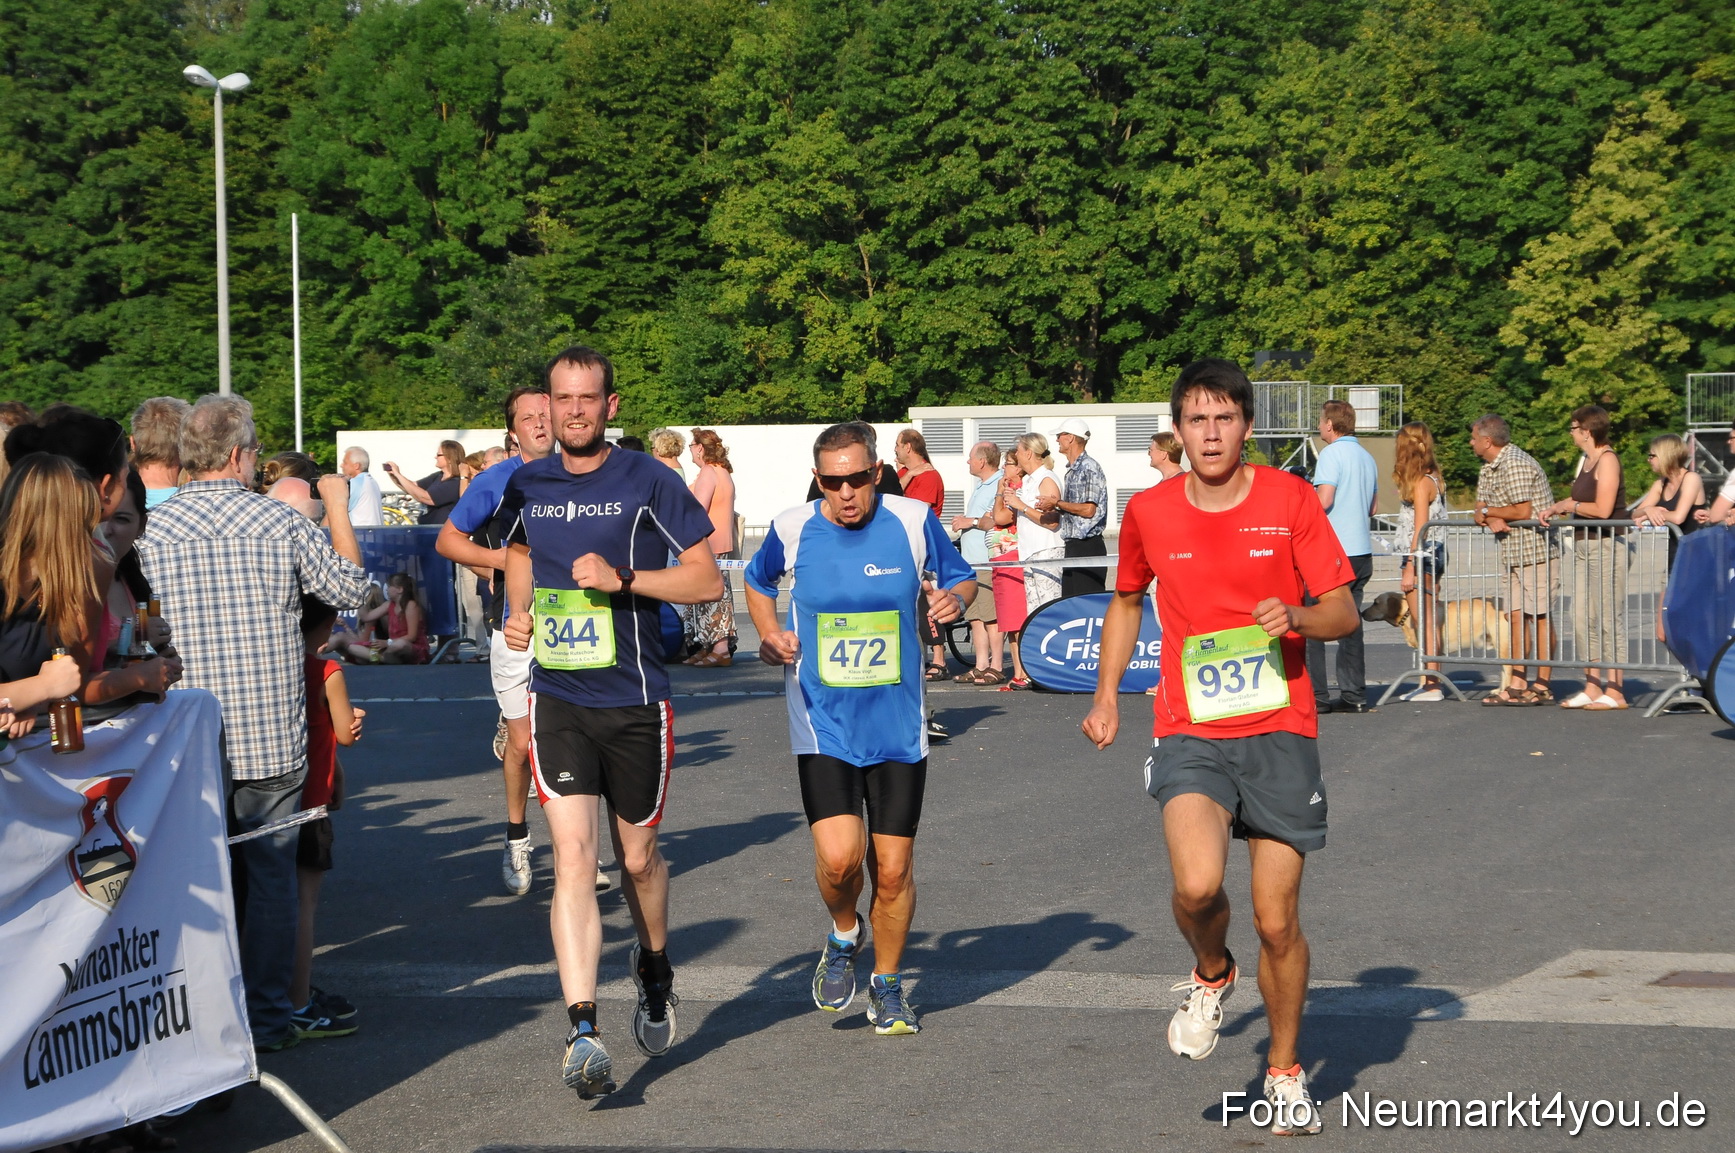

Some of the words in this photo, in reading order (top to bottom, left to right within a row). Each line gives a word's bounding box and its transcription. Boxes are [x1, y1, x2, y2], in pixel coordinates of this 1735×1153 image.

[531, 505, 565, 517] EURO
[577, 502, 622, 517] POLES
[1250, 549, 1274, 558] Florian
[544, 617, 600, 649] 344
[829, 637, 887, 668] 472
[1197, 655, 1266, 698] 937
